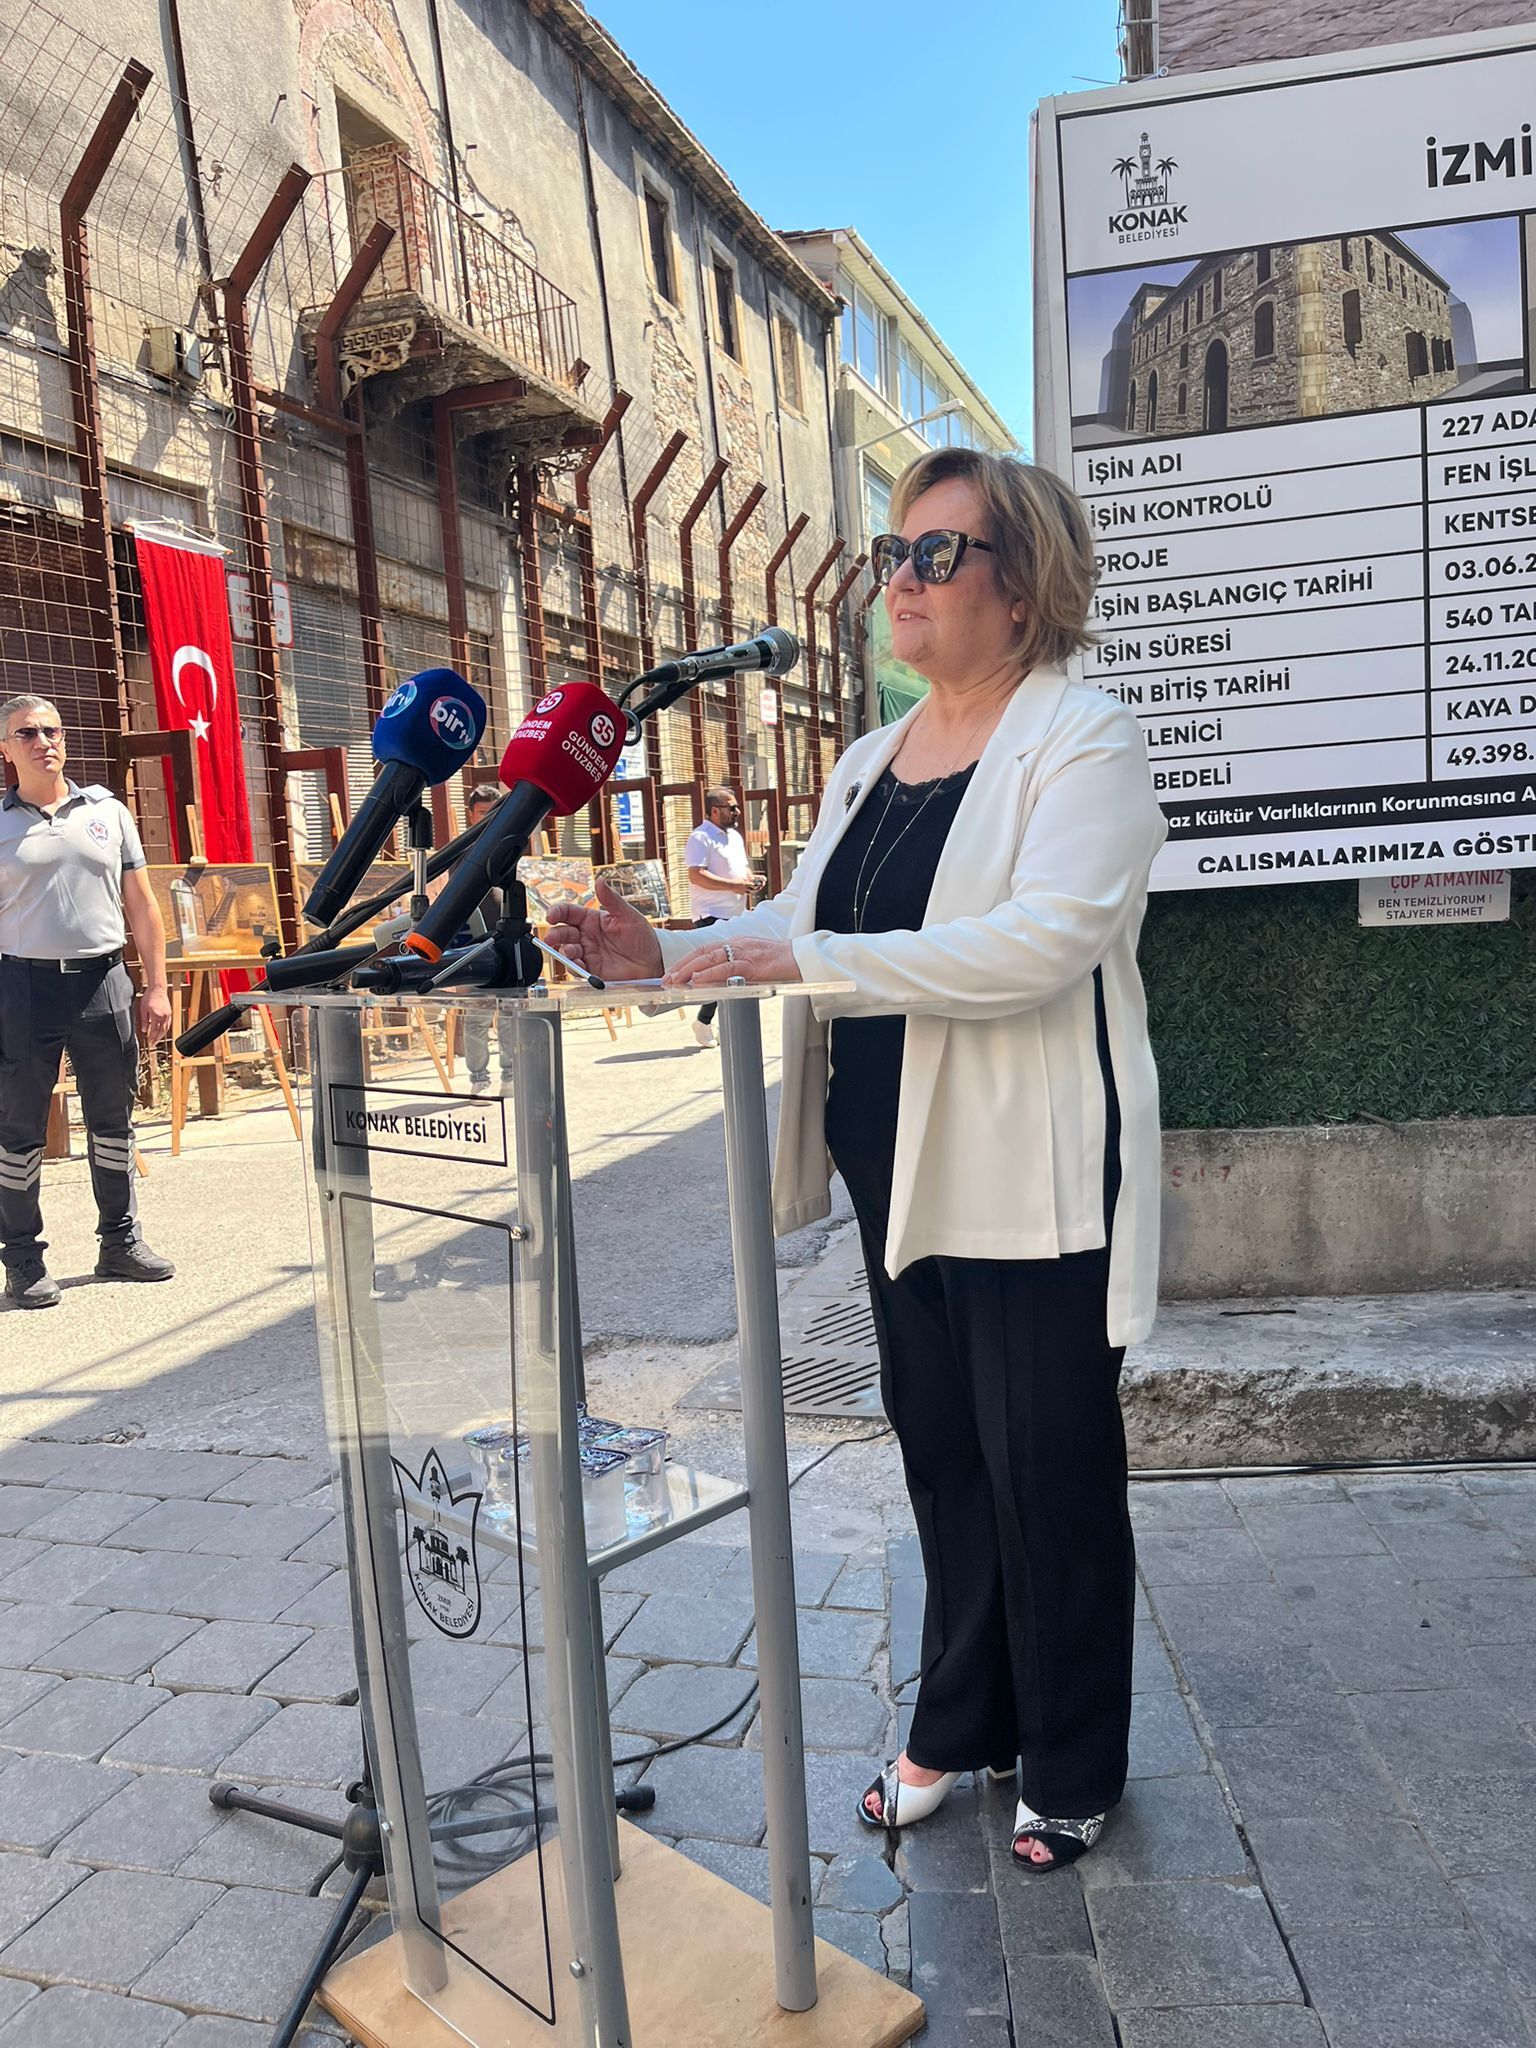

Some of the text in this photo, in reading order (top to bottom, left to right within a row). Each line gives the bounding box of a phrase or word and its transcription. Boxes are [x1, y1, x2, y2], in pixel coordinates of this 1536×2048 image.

[1426, 123, 1532, 188] İZMİ
[1108, 205, 1188, 233] KONAK
[1118, 224, 1179, 244] BELEDİYESİ
[1442, 414, 1484, 438] 227
[1088, 453, 1182, 485] İŞİN ADI
[1444, 455, 1536, 486] FEN İŞL
[1090, 484, 1272, 531] İŞİN KONTROLÜ
[1445, 553, 1536, 581] 03.06.2
[1095, 565, 1373, 621] İŞİN BAŞLANGIÇ TARİHİ
[1445, 602, 1536, 629] 540 TA
[1148, 628, 1231, 658] SÜRESİ
[1151, 676, 1208, 702] BİTİŞ
[1214, 667, 1290, 696] TARİHİ
[1447, 697, 1512, 721] KAYA
[593, 717, 614, 743] 35
[1143, 718, 1222, 747] LENİCİ
[561, 740, 602, 783] OTUZBEŞ
[568, 731, 609, 773] GÜNDEM
[1447, 742, 1534, 766] 49.398.
[1153, 761, 1232, 791] BEDELİ
[1196, 807, 1253, 827] Kültür
[1257, 799, 1376, 822] Varlıklarının
[1382, 791, 1515, 812] Korunmasına
[1453, 831, 1536, 856] GÖST
[1424, 869, 1504, 888] ATMAYINIZ
[1378, 898, 1401, 909] BEN
[1403, 894, 1485, 907] TEMİZLİYORUM
[1386, 906, 1484, 920] STAJYER MEHMET
[346, 1110, 487, 1143] KONAK BELEDİYESİ
